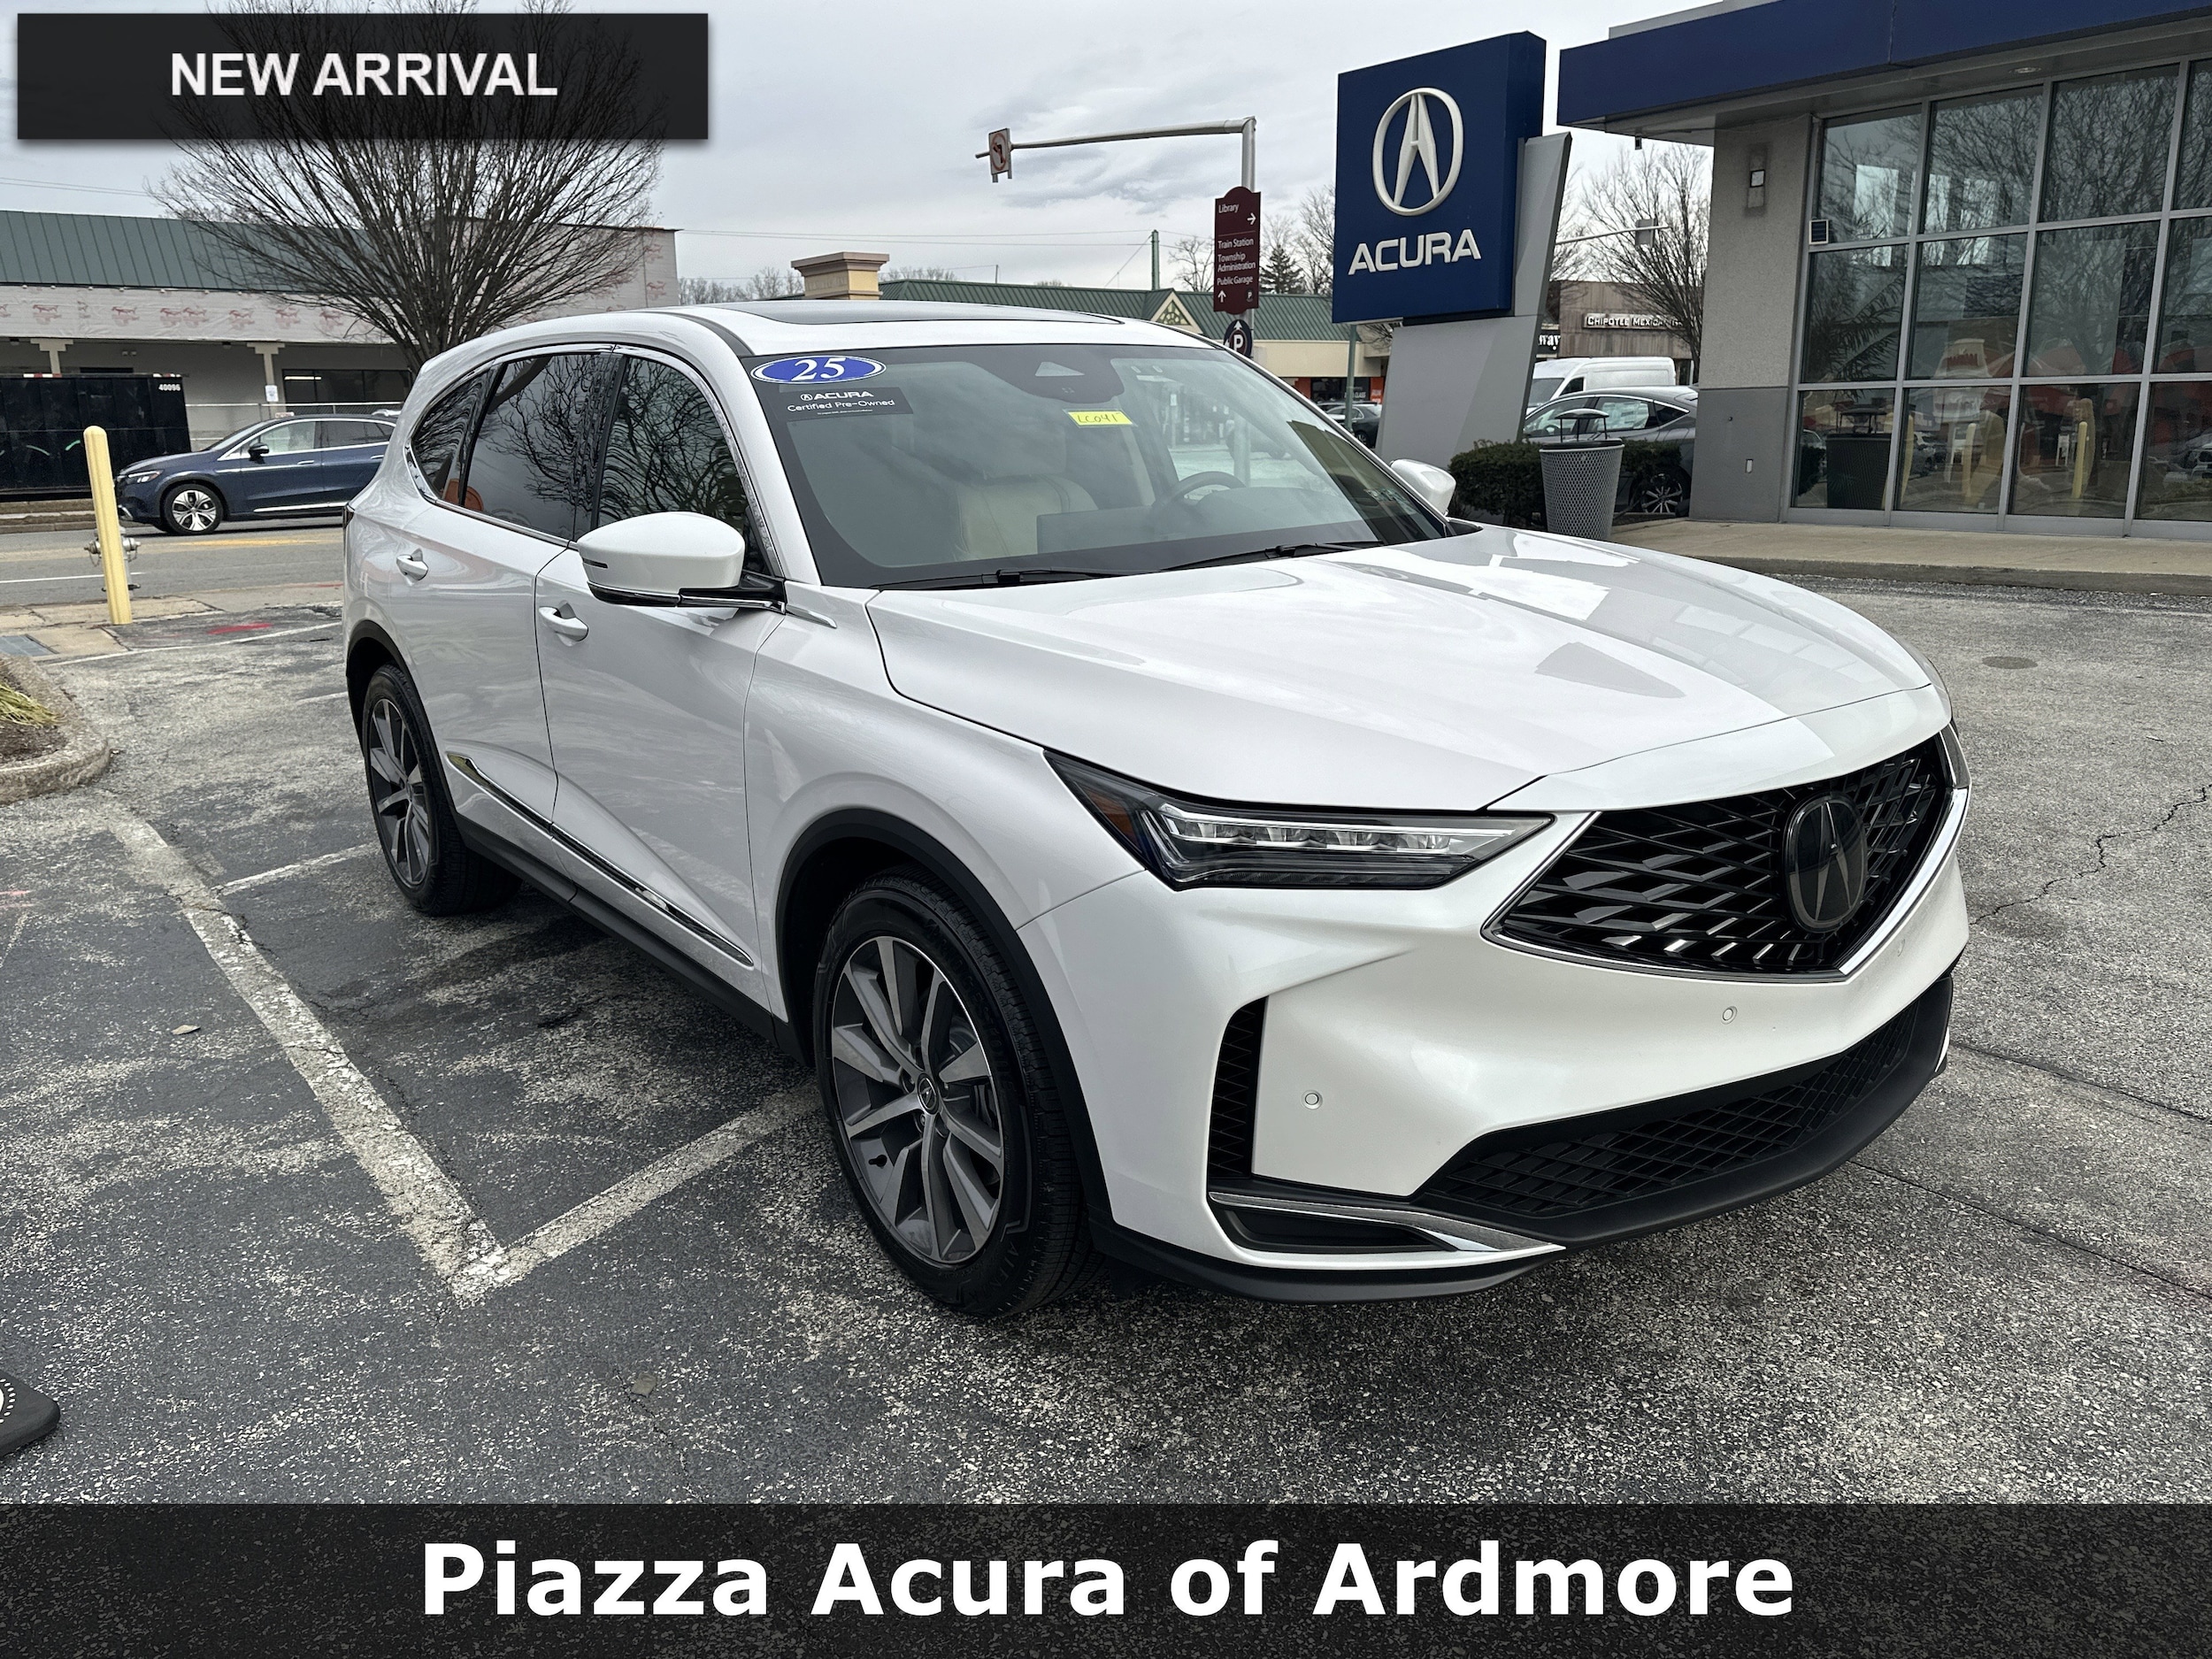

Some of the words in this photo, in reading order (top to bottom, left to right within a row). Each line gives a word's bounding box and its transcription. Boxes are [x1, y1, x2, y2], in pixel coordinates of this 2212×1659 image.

[1218, 204, 1239, 213] Library
[1217, 240, 1233, 250] Train
[1233, 237, 1254, 248] Station
[1348, 228, 1482, 275] ACURA
[1217, 252, 1246, 263] Township
[1217, 262, 1256, 273] Administration
[1217, 277, 1233, 286] Public
[1233, 275, 1253, 285] Garage
[1587, 316, 1630, 326] CHIPOTLE
[1233, 334, 1244, 352] P
[790, 357, 847, 381] 25
[813, 390, 874, 401] ACURA
[787, 402, 833, 412] Certified
[834, 399, 895, 408] Pre-Owned
